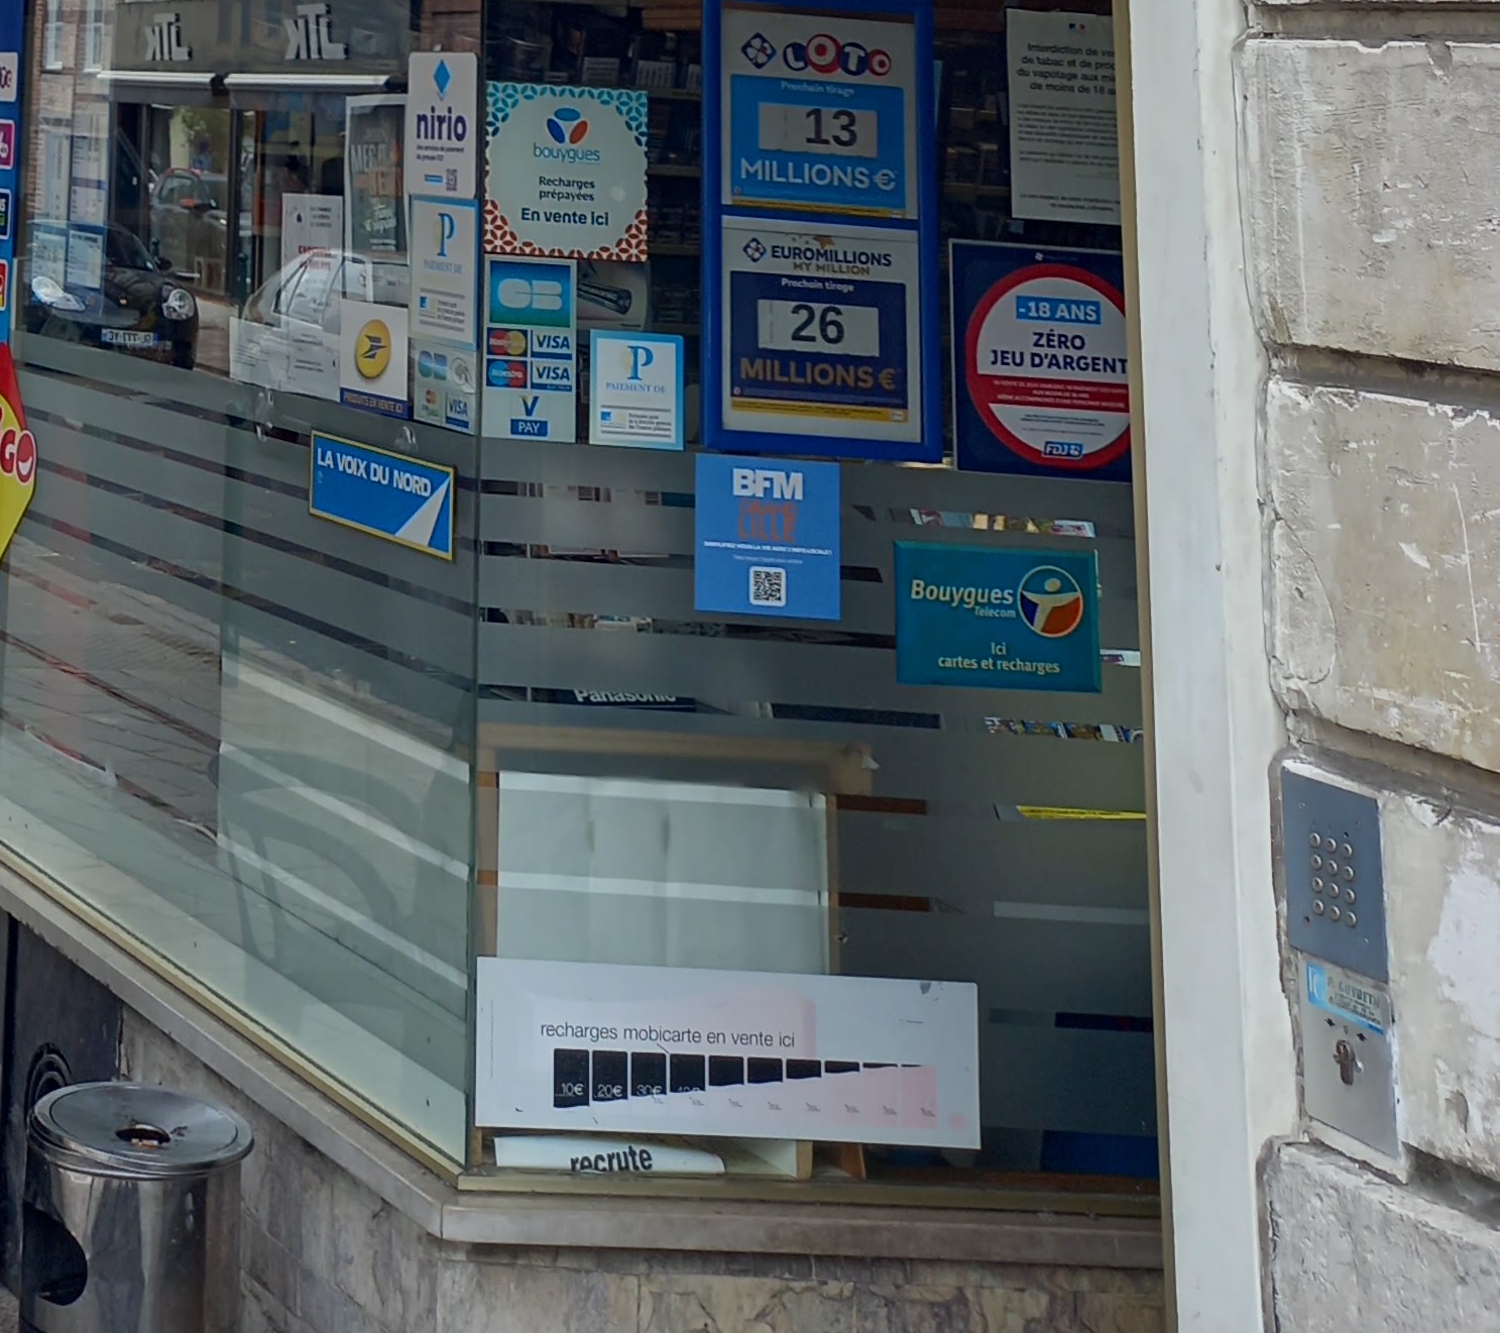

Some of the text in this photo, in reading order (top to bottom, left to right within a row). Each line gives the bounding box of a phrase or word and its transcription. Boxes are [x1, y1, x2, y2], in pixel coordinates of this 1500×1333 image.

[783, 33, 892, 77] LOTO
[1027, 42, 1083, 56] Interdiction
[1086, 45, 1098, 56] de
[1021, 55, 1034, 65] de
[1036, 55, 1065, 68] tabac
[1079, 58, 1093, 69] de
[1016, 68, 1030, 77] du
[1032, 70, 1078, 82] vapotage
[1081, 73, 1098, 82] aux
[780, 80, 855, 97] Prochain tirage
[1029, 81, 1043, 91] de
[1045, 81, 1075, 93] moins
[1077, 84, 1091, 94] de
[416, 105, 467, 142] nirio
[805, 108, 858, 147] 13
[533, 143, 601, 165] bouygues
[538, 176, 596, 190] Recharges
[740, 157, 871, 190] MILLIONS
[538, 189, 596, 202] prépayées
[520, 207, 541, 221] En
[543, 211, 588, 225] vente
[771, 245, 892, 266] EUROMILLIONS
[792, 261, 871, 276] MY MILLION
[780, 277, 855, 293] Prochain tirage
[1055, 303, 1098, 322] ANS
[790, 303, 845, 345] 26
[535, 334, 570, 350] VISA
[1032, 328, 1086, 351] ZÉRO
[990, 349, 1128, 375] JEU D'ARGENT
[535, 365, 570, 381] VISA
[739, 356, 875, 390] MILLIONS
[605, 382, 651, 394] PAIEMENT
[447, 396, 469, 416] VISA
[517, 421, 541, 434] PAY
[1044, 441, 1069, 457] FDJ
[317, 447, 432, 498] LA VOIX DU NORD
[732, 467, 804, 501] BFM
[910, 579, 1014, 609] Bouygues
[974, 606, 1016, 618] Telecom
[938, 656, 1060, 675] cartes et recharges
[540, 1022, 795, 1048] recharges mobicarte en vente ici
[561, 1082, 585, 1096] 10€
[597, 1083, 623, 1098] 20€
[570, 1144, 653, 1172] recrute
